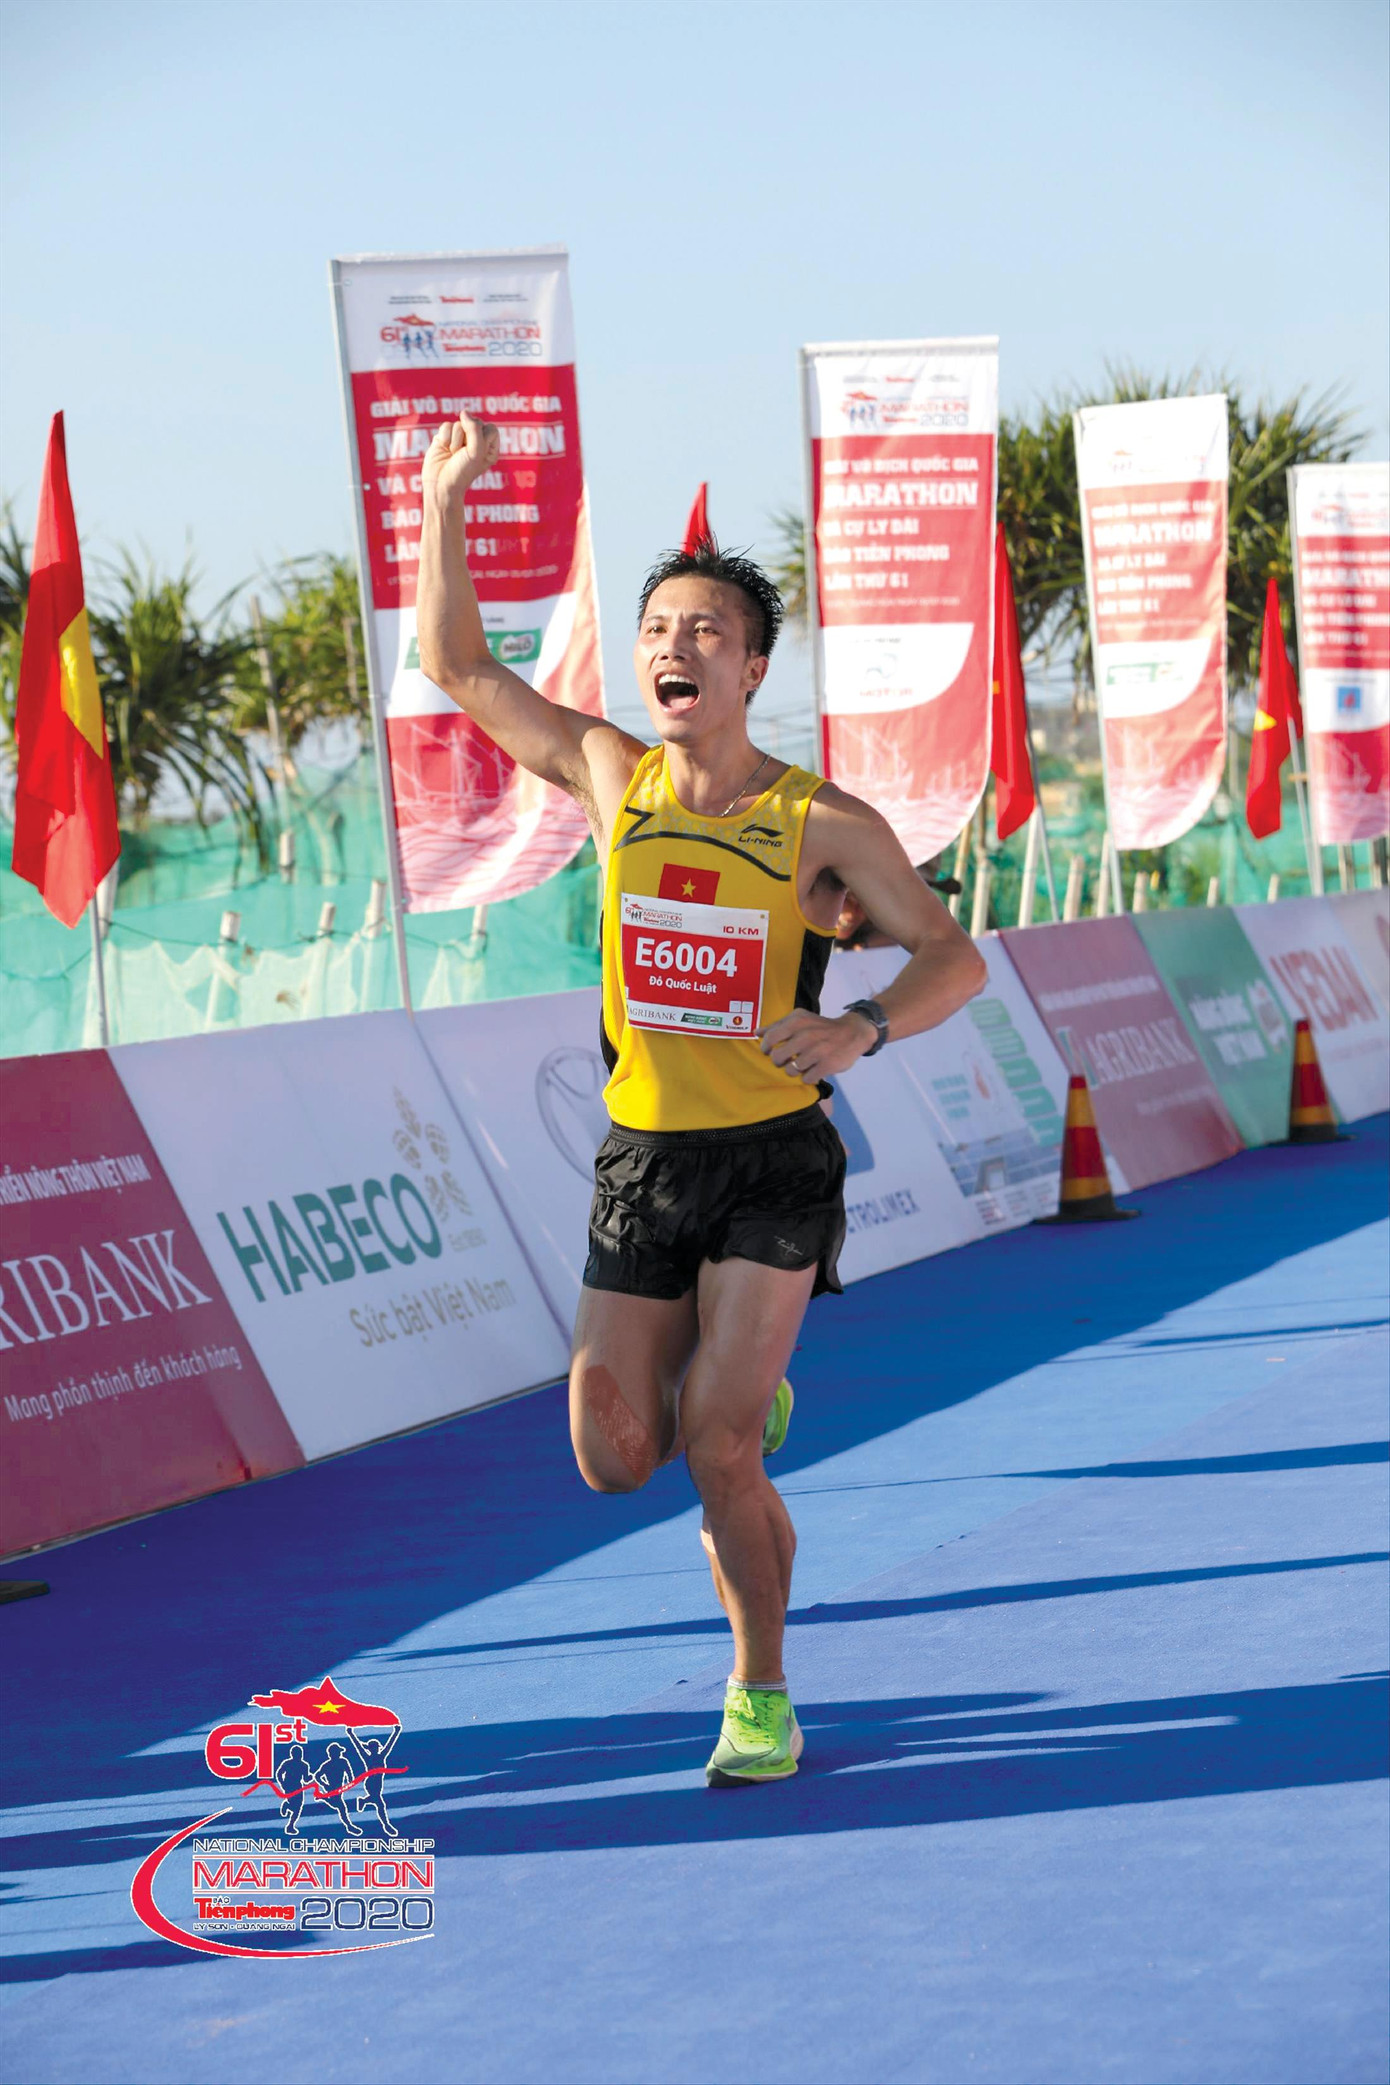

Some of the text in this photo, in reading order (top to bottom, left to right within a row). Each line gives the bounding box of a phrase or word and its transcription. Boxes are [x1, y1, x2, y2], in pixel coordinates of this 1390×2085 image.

[488, 341, 543, 356] 2020
[532, 396, 562, 413] GIA
[373, 424, 566, 461] MAHON
[823, 480, 979, 509] MARATHON
[476, 503, 540, 524] PHONG
[475, 537, 498, 556] 61
[738, 835, 783, 848] LI-NING
[660, 919, 683, 929] 2020
[723, 925, 759, 936] 10 KM
[634, 936, 738, 978] E6004
[665, 977, 692, 991] Quốc
[693, 981, 717, 995] Luật
[59, 1158, 101, 1194] THÔN
[116, 1153, 152, 1184] NAM
[215, 1172, 443, 1303] HABECO
[425, 1281, 474, 1330] Việt
[464, 1276, 517, 1316] Nam
[3, 1393, 54, 1422] Mang
[159, 1349, 207, 1381] khách
